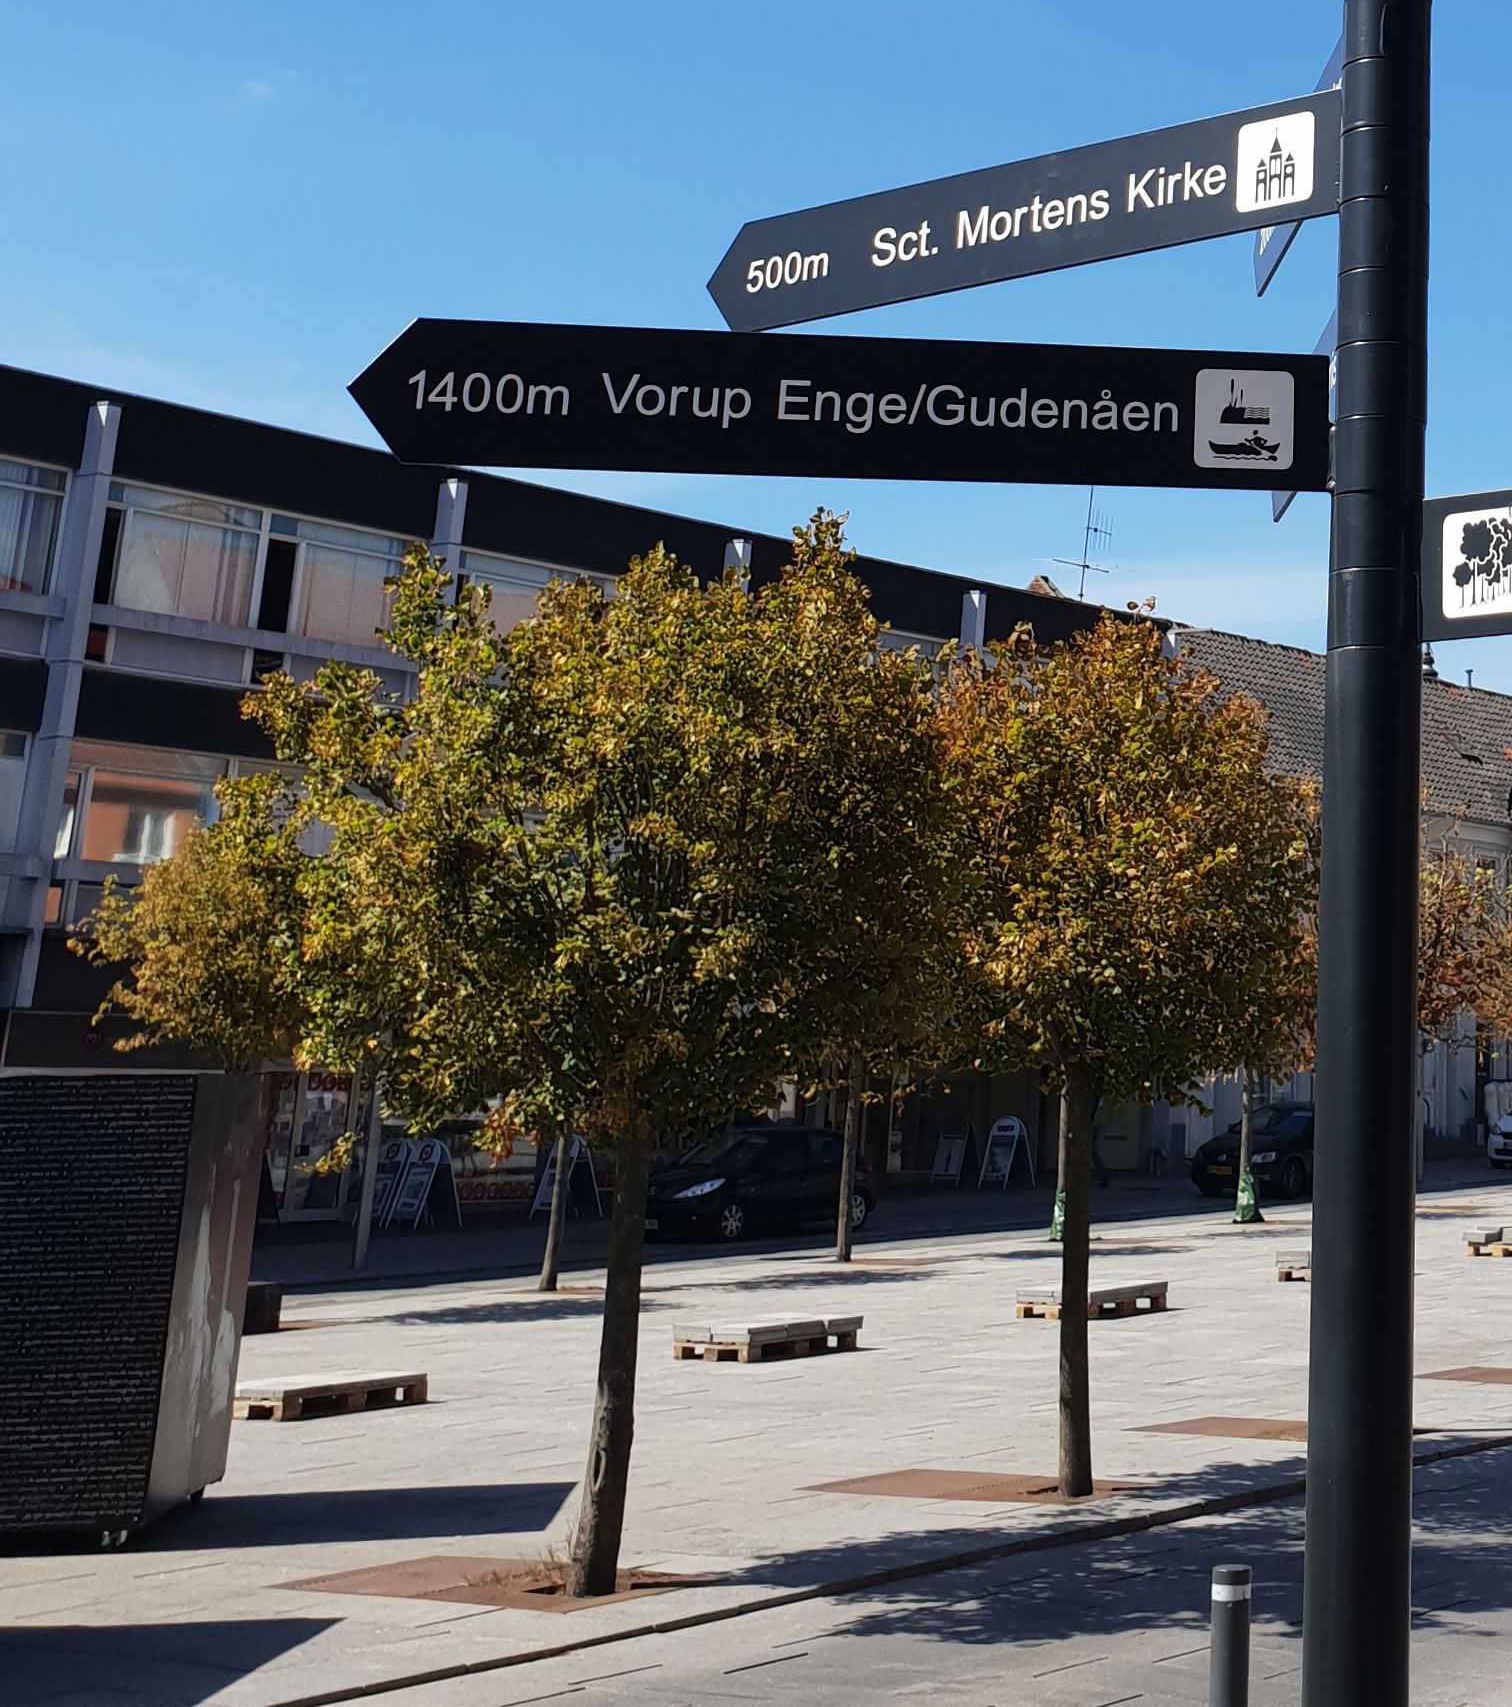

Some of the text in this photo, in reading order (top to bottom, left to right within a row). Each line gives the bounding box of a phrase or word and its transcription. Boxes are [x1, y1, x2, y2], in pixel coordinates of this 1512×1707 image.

[747, 162, 1226, 292] 500m Sct. Mortens Kirke
[409, 370, 1178, 433] 1400m Vorup Enge/Gudenåen
